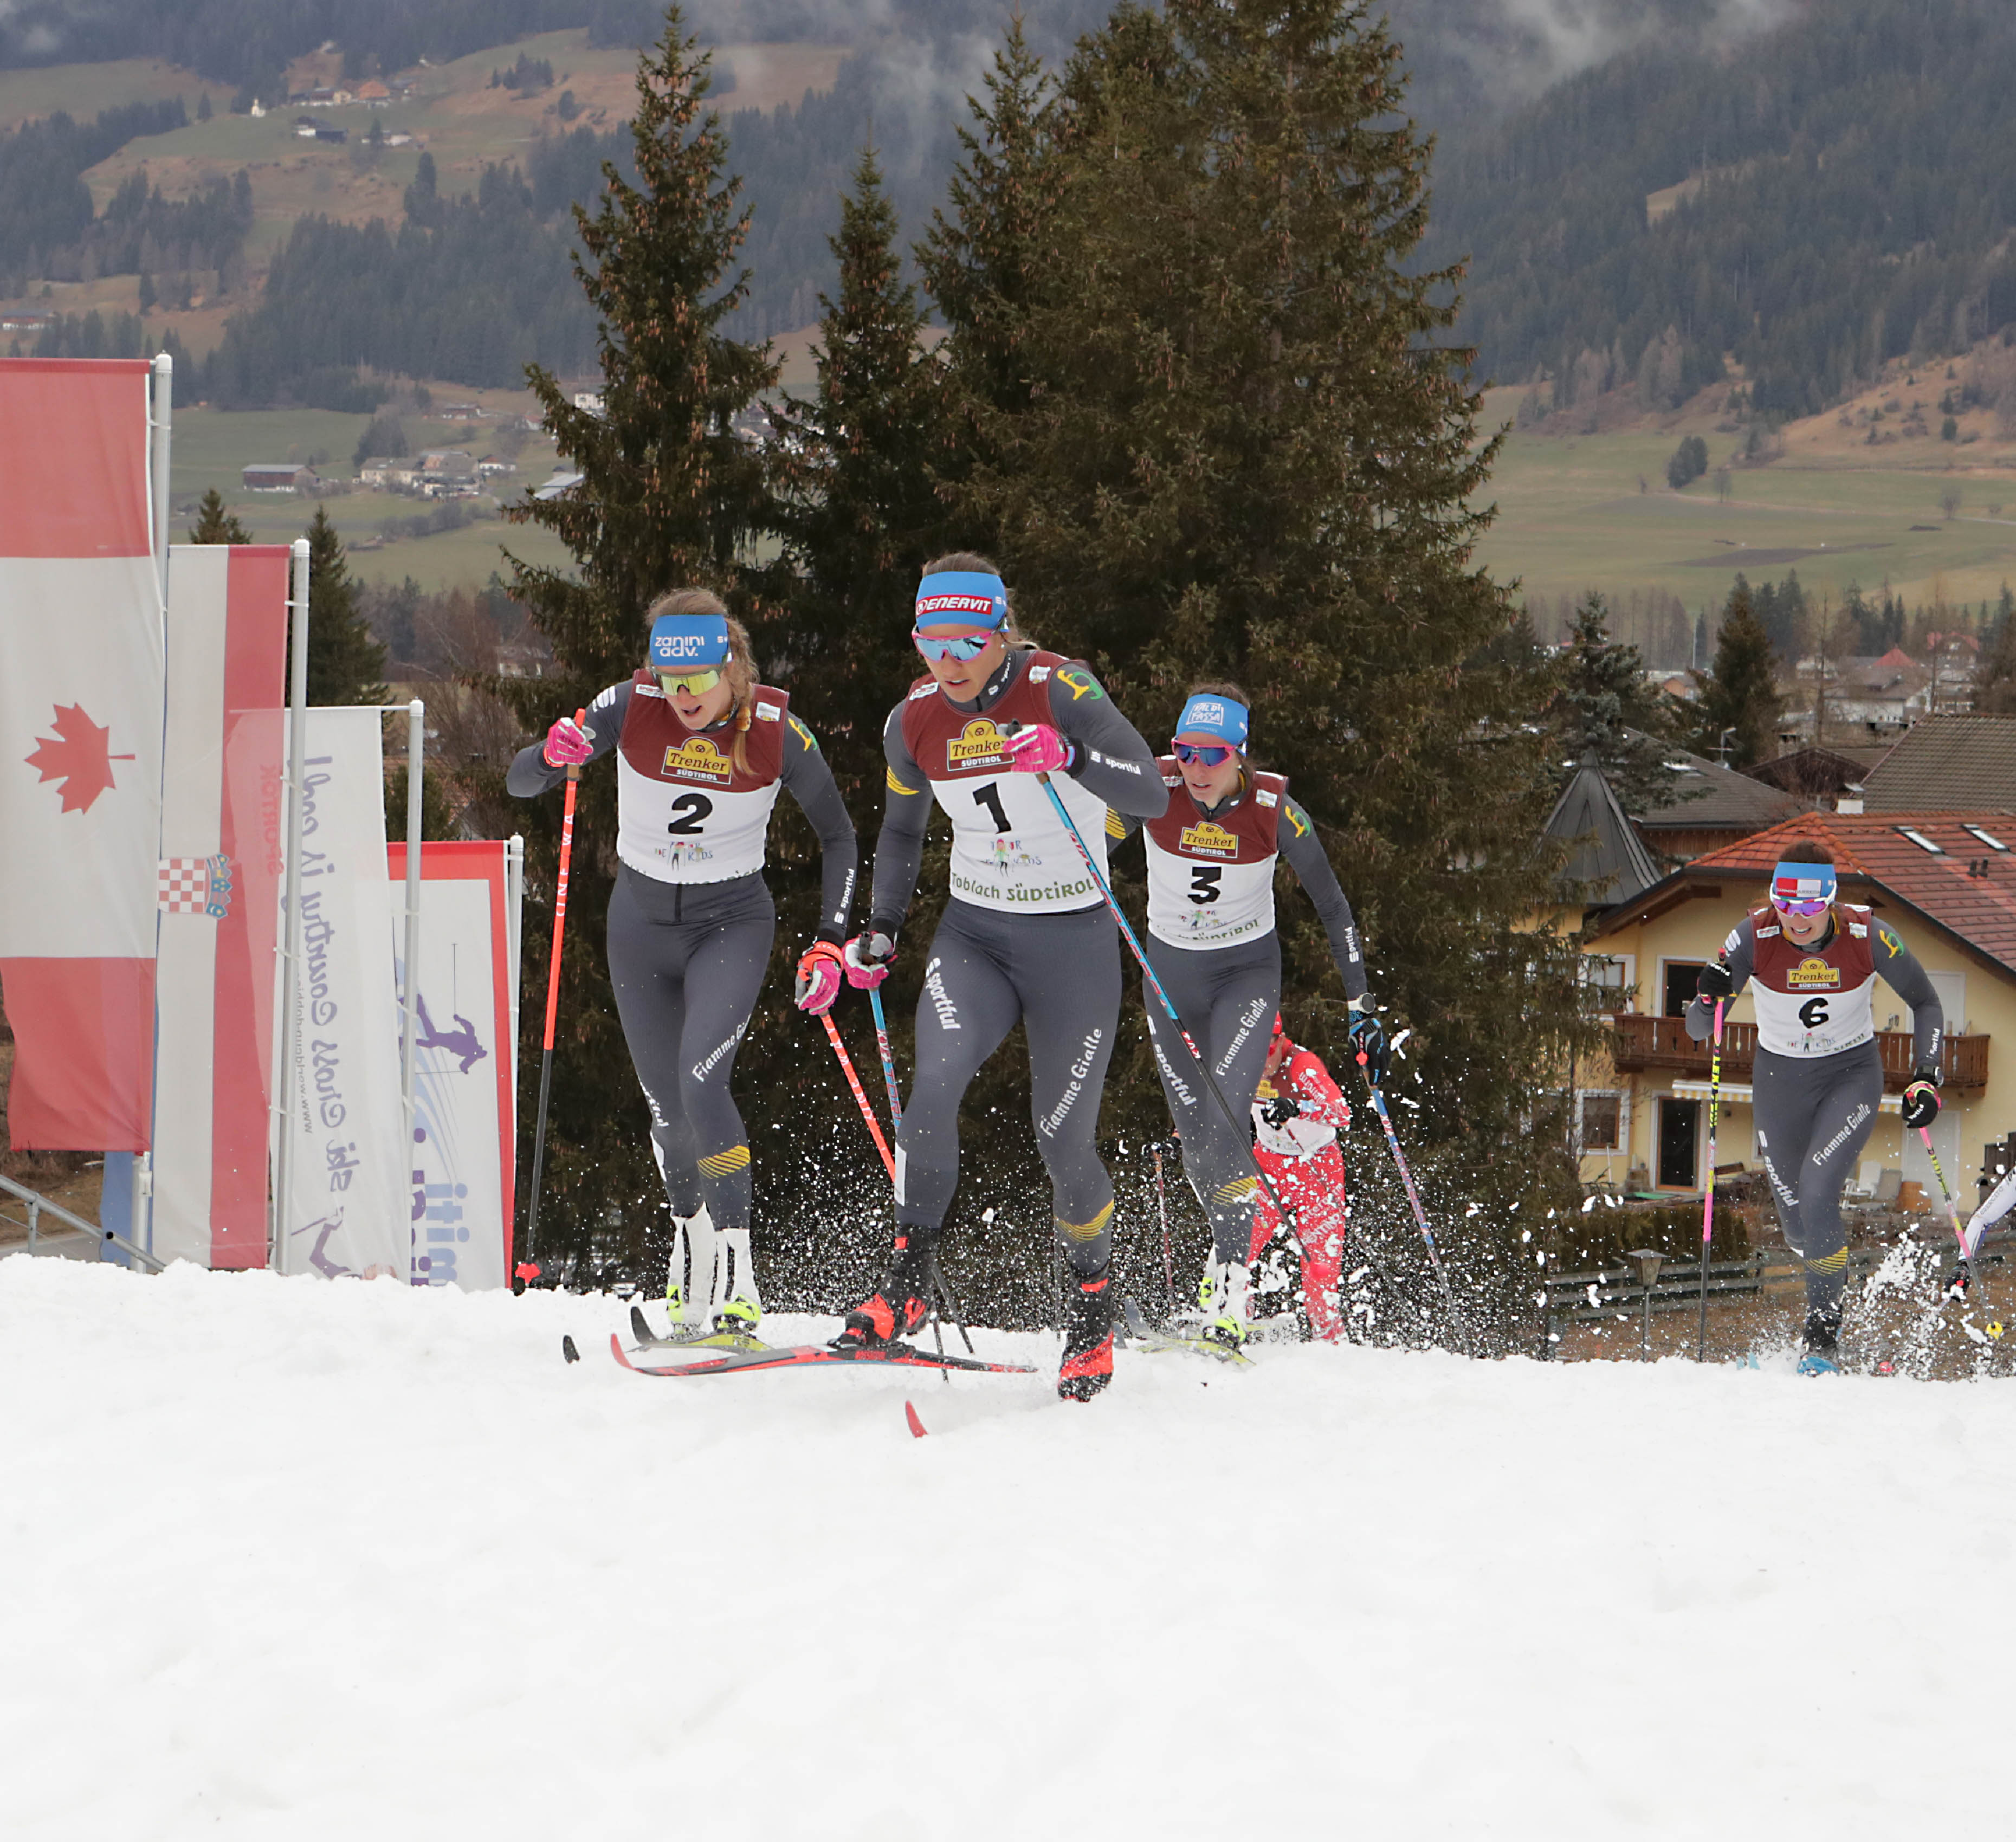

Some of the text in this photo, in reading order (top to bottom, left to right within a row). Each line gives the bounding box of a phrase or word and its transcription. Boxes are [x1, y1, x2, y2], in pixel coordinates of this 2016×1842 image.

[926, 597, 991, 611] ENERVIT
[655, 636, 706, 647] zanini
[1192, 712, 1220, 722] FASSA
[671, 753, 727, 771] Trenker
[676, 769, 718, 781] SÜDTIROL
[961, 755, 1001, 767] SÜDTIROL
[1105, 758, 1142, 775] sportful
[668, 792, 713, 835] 2
[973, 781, 1012, 834] 1
[1186, 832, 1233, 848] Trenker
[1192, 846, 1226, 856] SÜDTIROL
[841, 868, 855, 909] sportful
[952, 872, 1000, 899] Toblach
[1187, 867, 1222, 904] 3
[1792, 972, 1836, 981] Trenker
[926, 973, 961, 1030] sportful
[1799, 997, 1829, 1029] 6
[1217, 997, 1268, 1077] Fiamme Gialle
[693, 1036, 736, 1082] Fiamme
[1155, 1043, 1194, 1107] sportful
[1039, 1028, 1102, 1139] Fiamme Gialle
[1813, 1103, 1871, 1166] Fiamme Gialle
[1764, 1156, 1799, 1207] sportful
